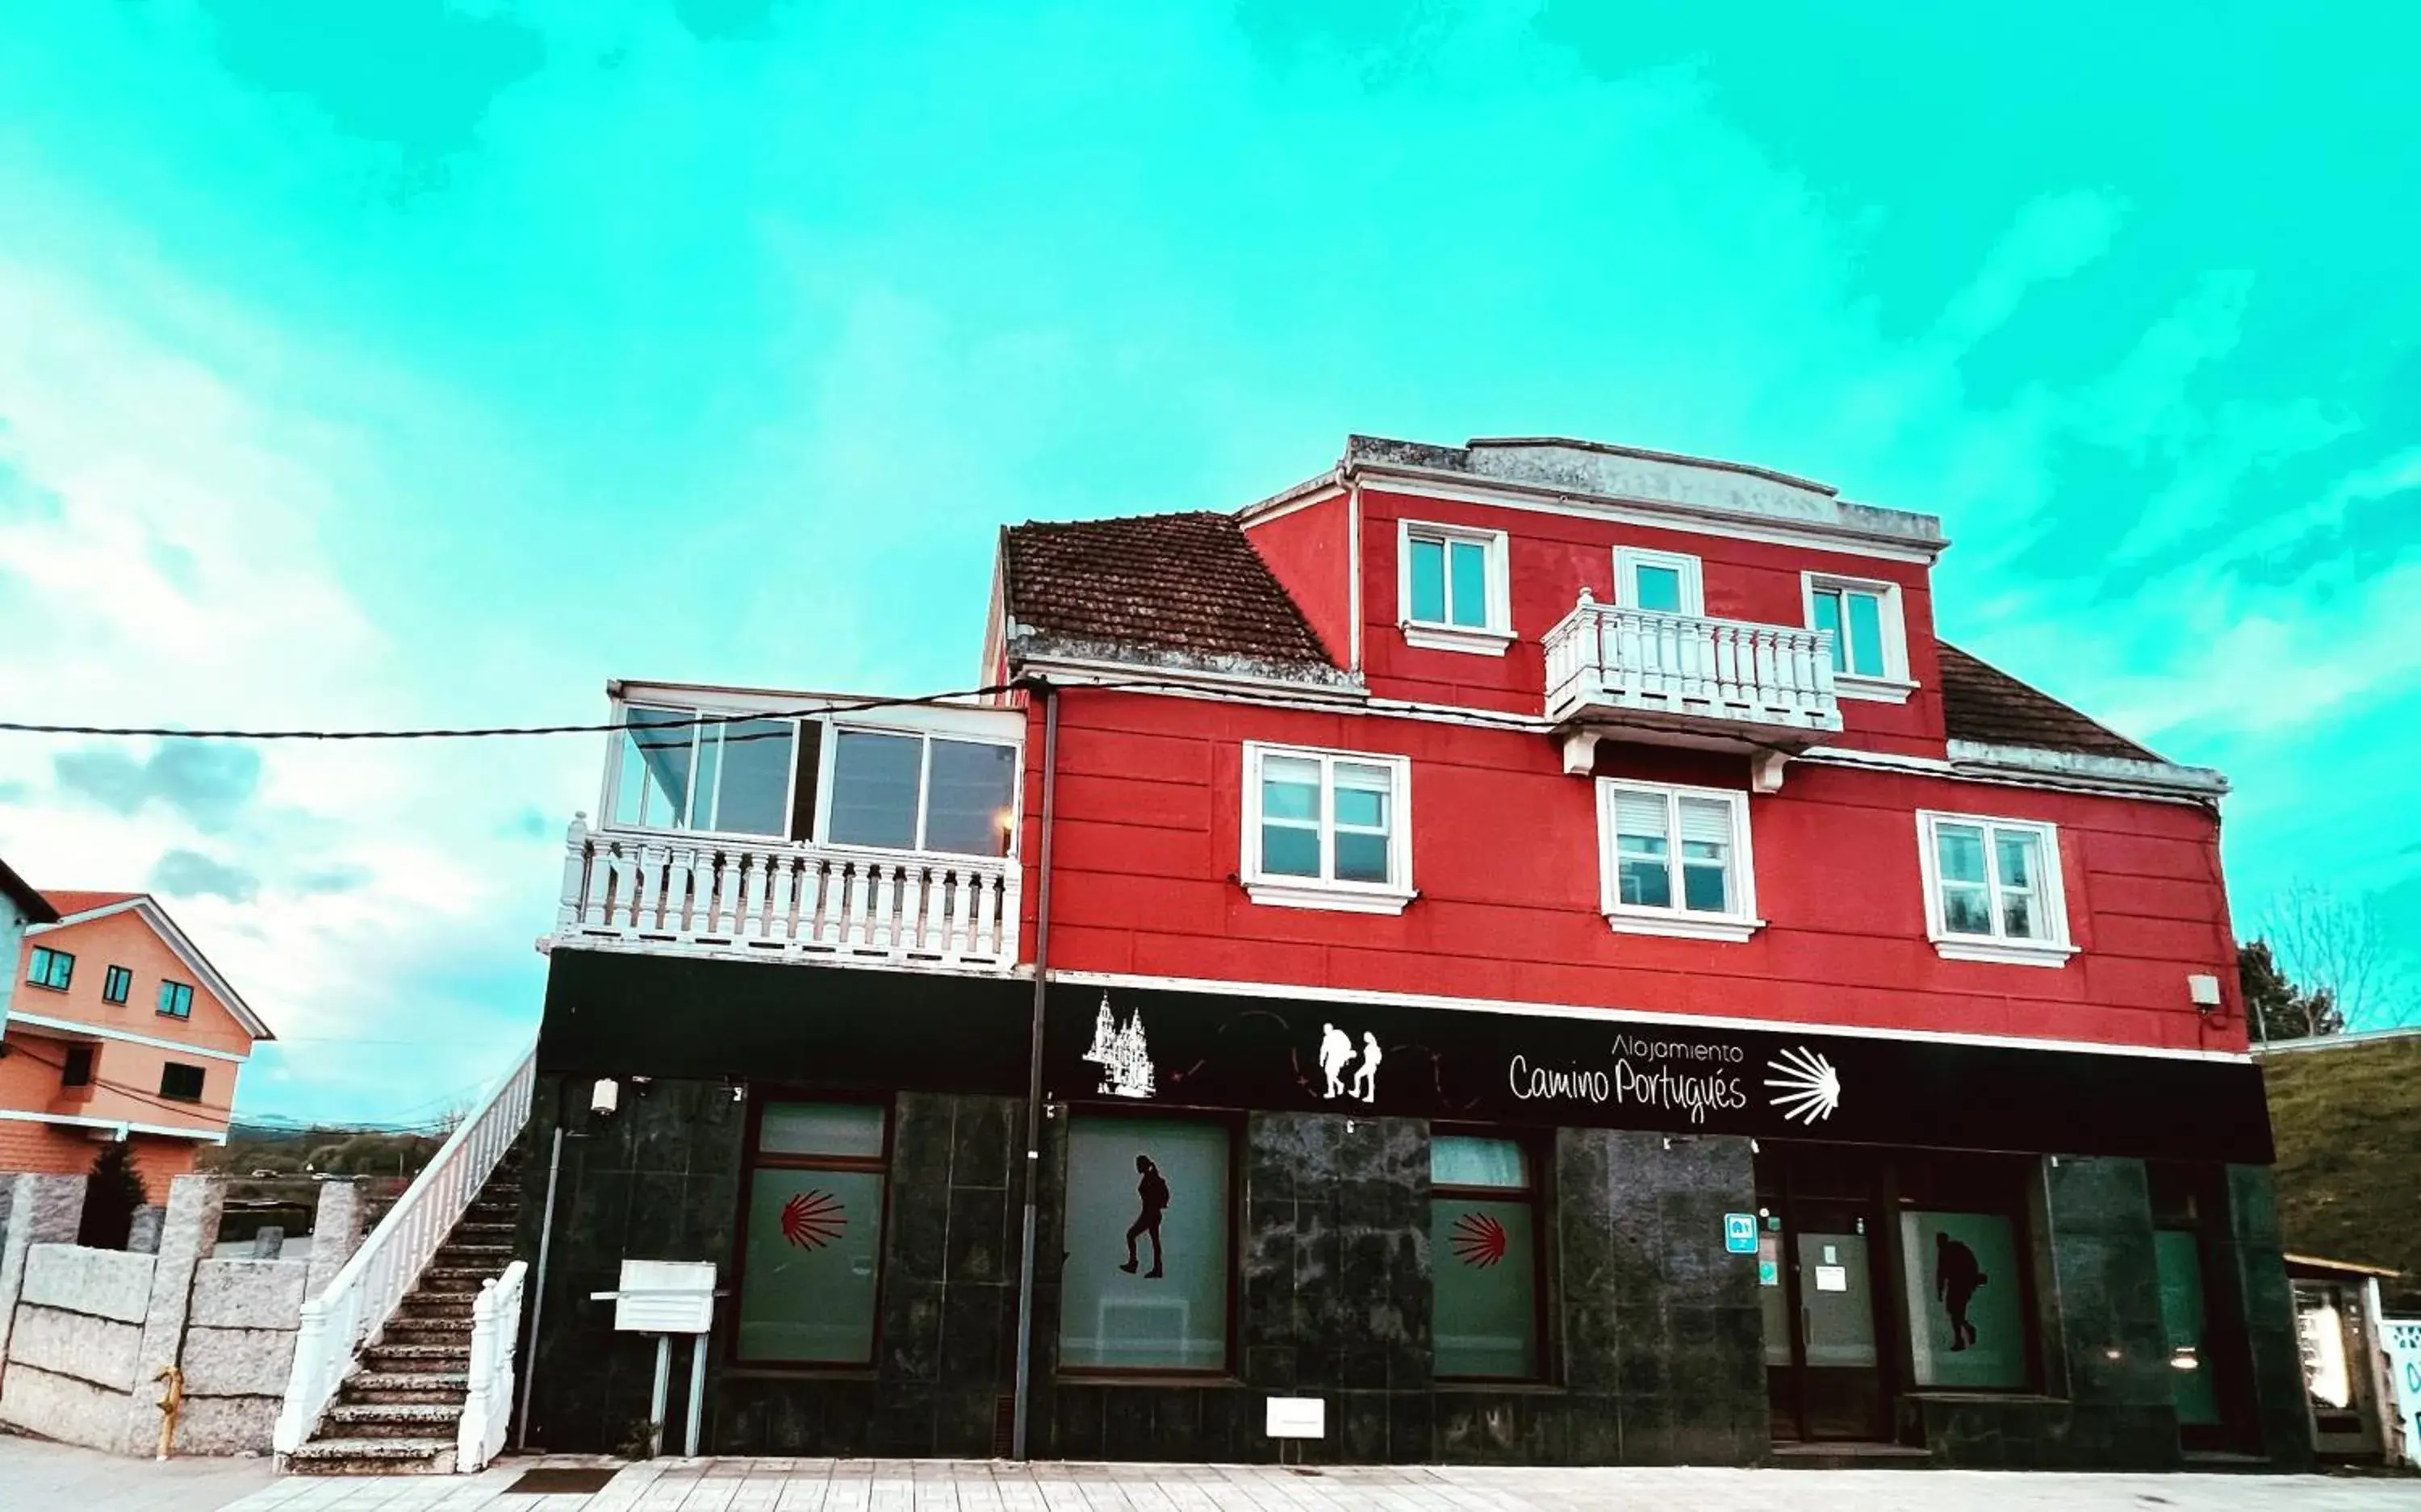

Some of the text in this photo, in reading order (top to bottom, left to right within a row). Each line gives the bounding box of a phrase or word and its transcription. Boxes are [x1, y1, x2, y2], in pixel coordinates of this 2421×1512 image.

[1612, 1034, 1744, 1063] Alojamiento
[1510, 1055, 1746, 1124] Camino Portugués
